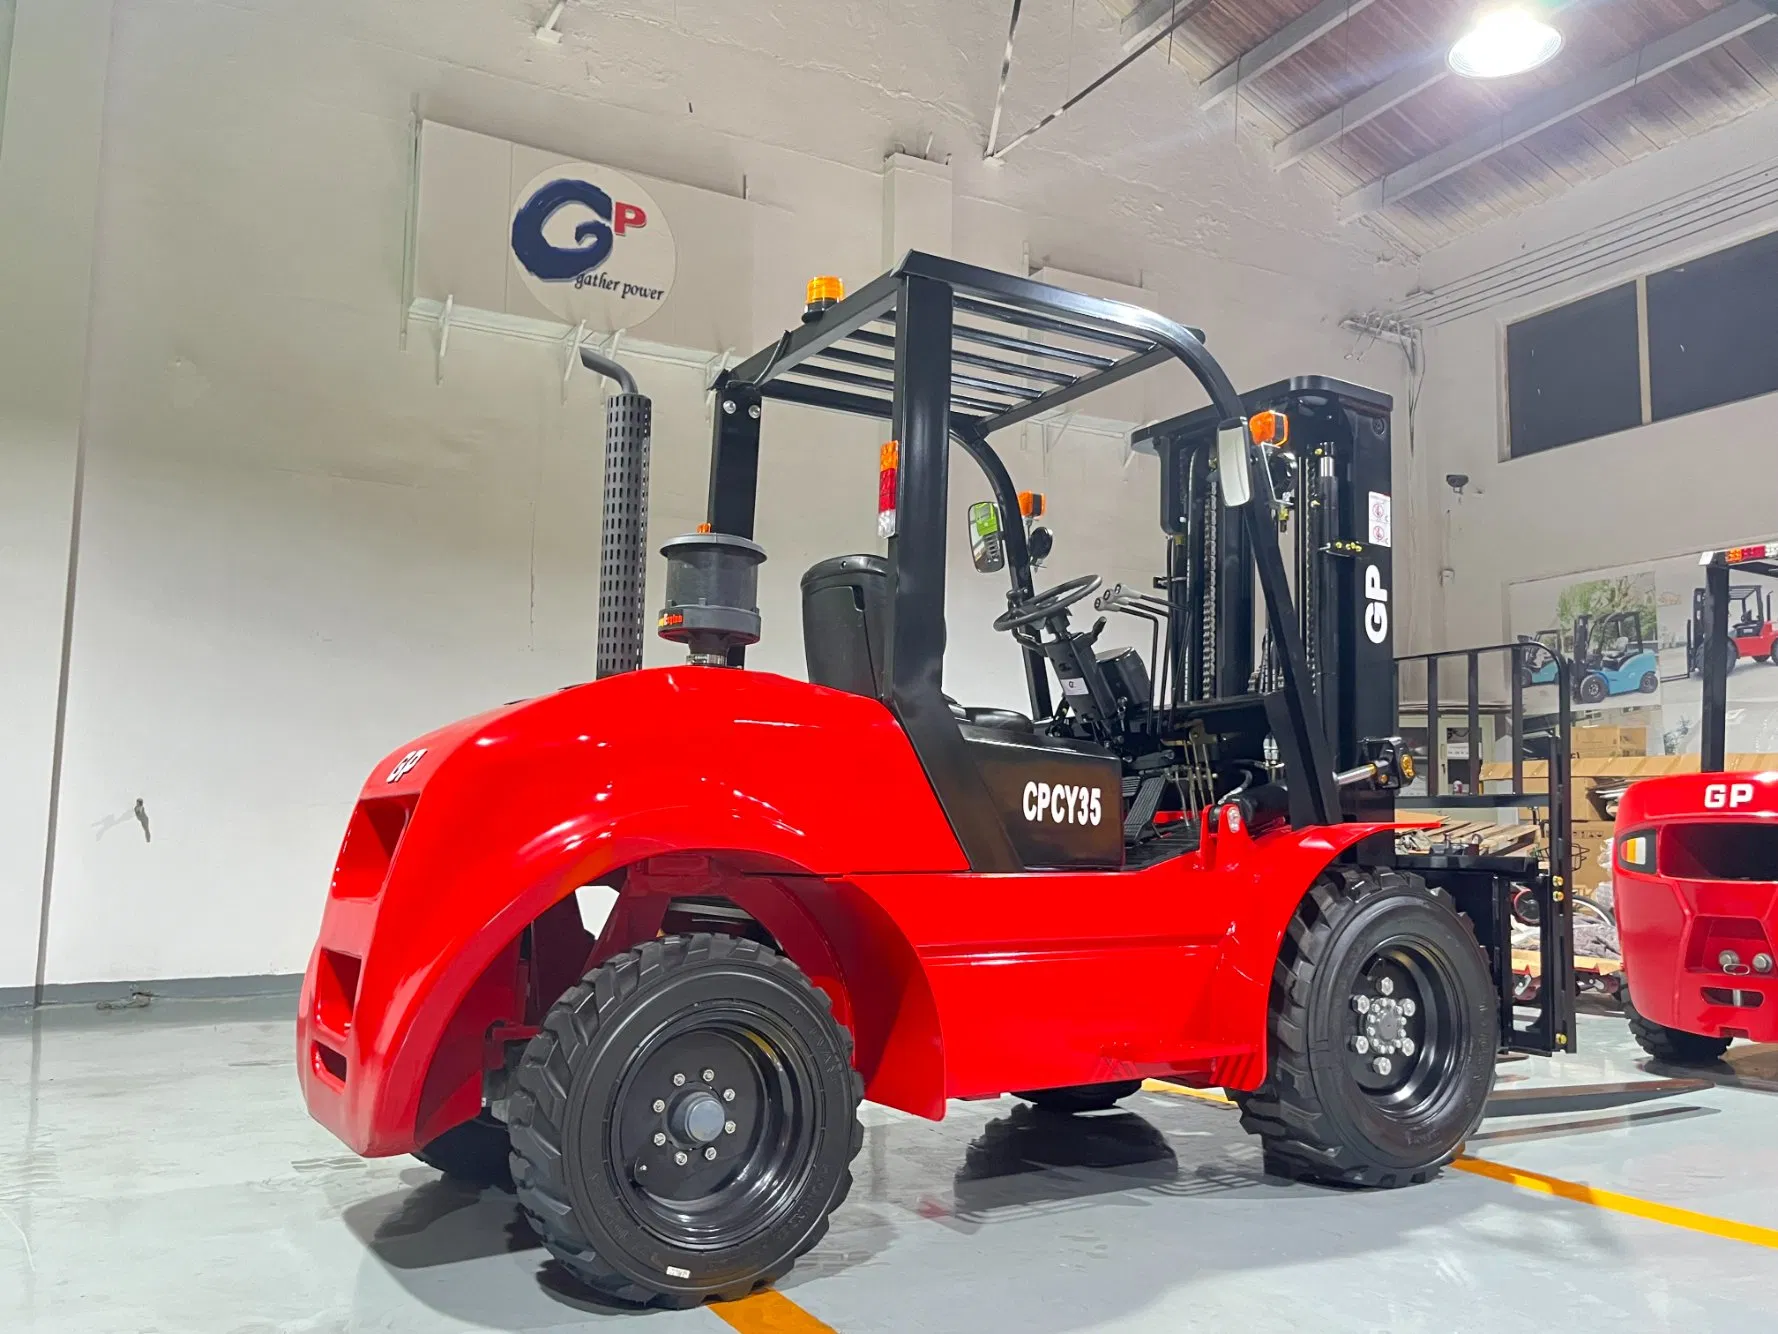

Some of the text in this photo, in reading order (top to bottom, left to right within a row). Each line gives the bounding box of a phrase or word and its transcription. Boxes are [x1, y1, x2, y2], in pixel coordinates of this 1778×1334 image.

[511, 178, 647, 283] GP
[574, 272, 665, 300] gather power
[1365, 564, 1388, 644] GP
[386, 748, 428, 784] GP
[1022, 781, 1102, 826] CPCY35
[1704, 783, 1754, 809] GP
